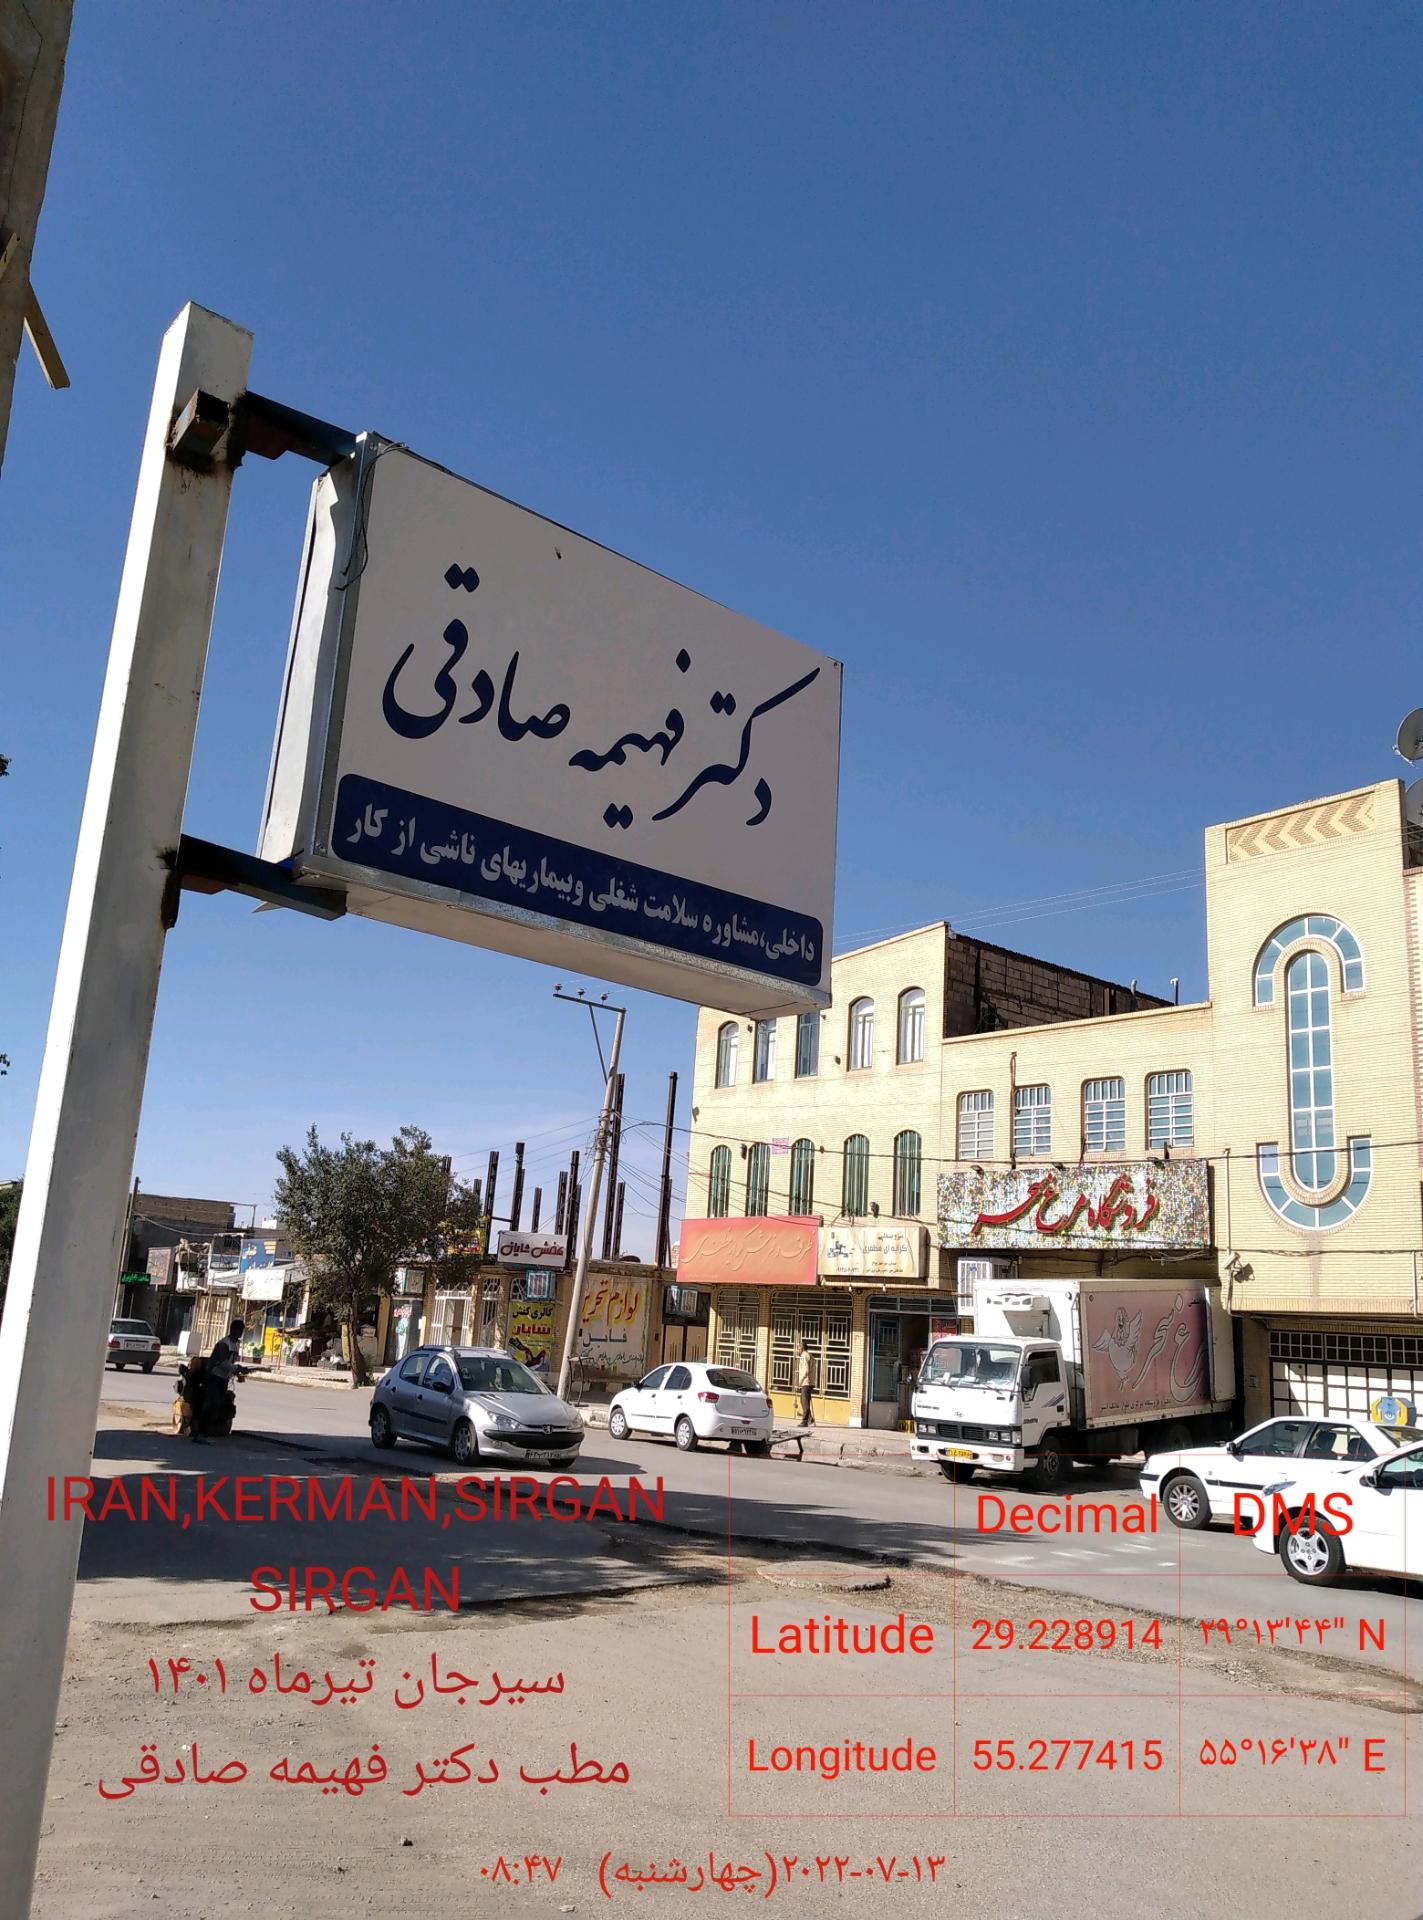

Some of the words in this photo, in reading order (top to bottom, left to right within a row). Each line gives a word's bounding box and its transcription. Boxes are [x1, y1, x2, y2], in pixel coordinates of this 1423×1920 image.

[382, 563, 571, 741] صادقی
[568, 648, 692, 829] فهیمه
[652, 666, 821, 826] دکتر
[346, 803, 389, 843] کار
[391, 816, 416, 856] از
[420, 829, 476, 865] ناشی
[588, 877, 638, 912] شغلی
[643, 894, 698, 930] سلامت
[1036, 1173, 1088, 1233] مرغ
[1087, 1172, 1157, 1229] فروشگاه
[500, 1241, 530, 1257] شایان
[531, 1241, 564, 1258] کفش
[607, 1288, 639, 1326] لوازم
